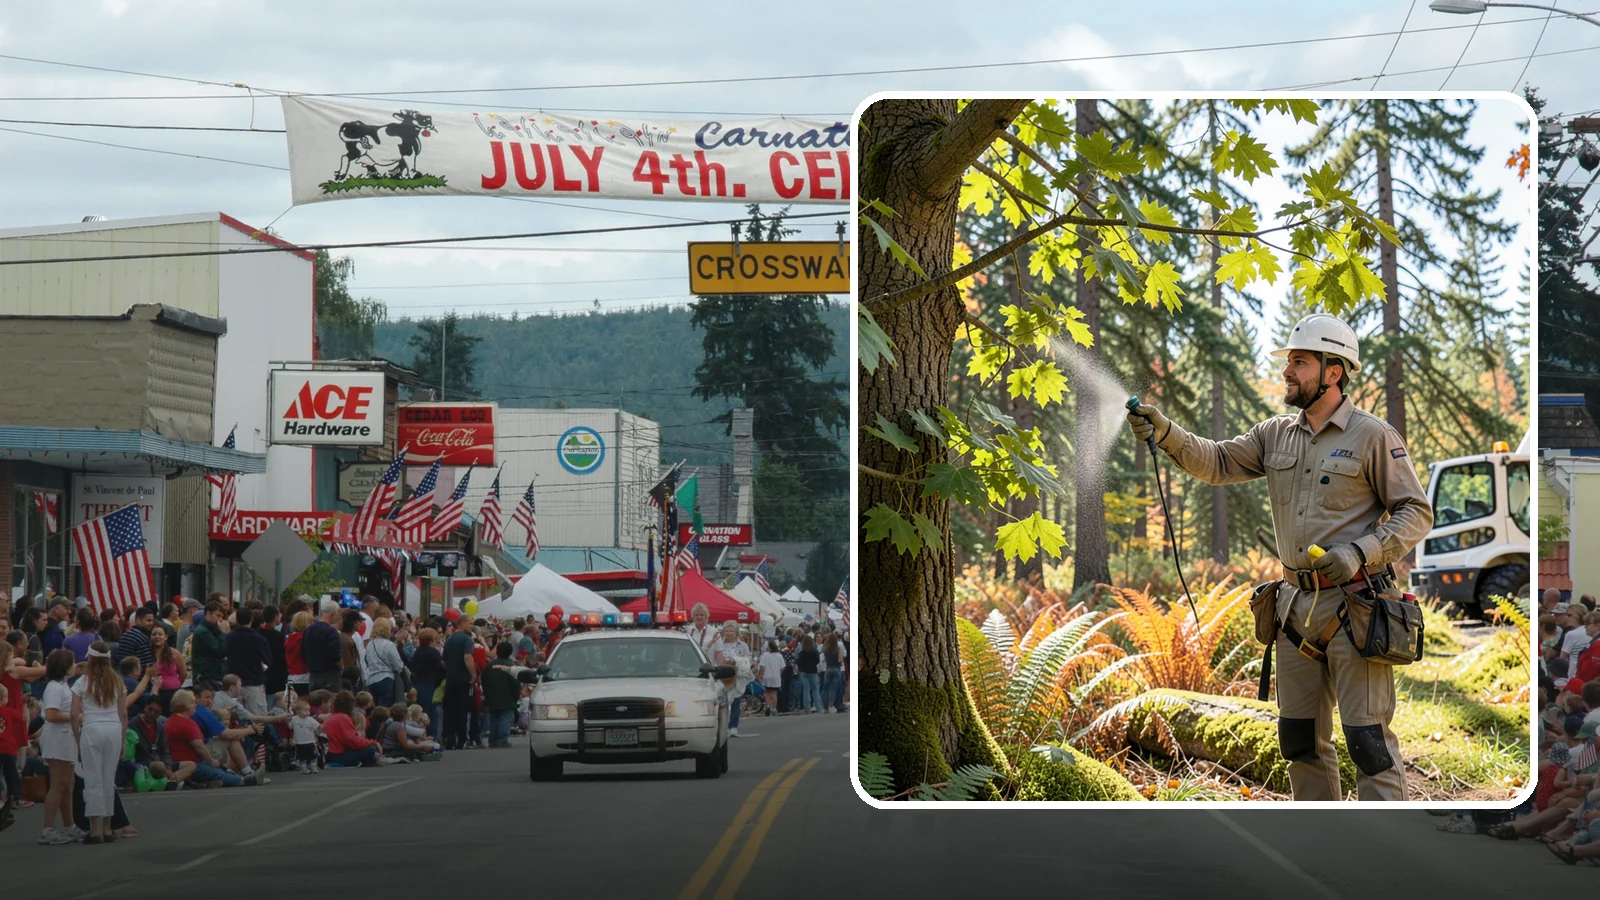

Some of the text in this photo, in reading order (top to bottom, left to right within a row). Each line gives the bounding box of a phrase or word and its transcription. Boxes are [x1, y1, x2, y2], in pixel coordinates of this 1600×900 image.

[695, 121, 850, 149] Carnat
[481, 141, 605, 192] JULY
[632, 150, 746, 197] 4th.
[697, 254, 850, 280] CROSSWA
[282, 380, 373, 419] ACE
[406, 409, 452, 422] CEDAR
[283, 421, 370, 436] Hardware
[354, 467, 384, 479] Simpl
[96, 485, 124, 495] Vincent
[126, 486, 135, 495] de
[138, 487, 155, 495] Paul
[688, 526, 741, 535] CRNATION
[699, 535, 730, 543] GLASS
